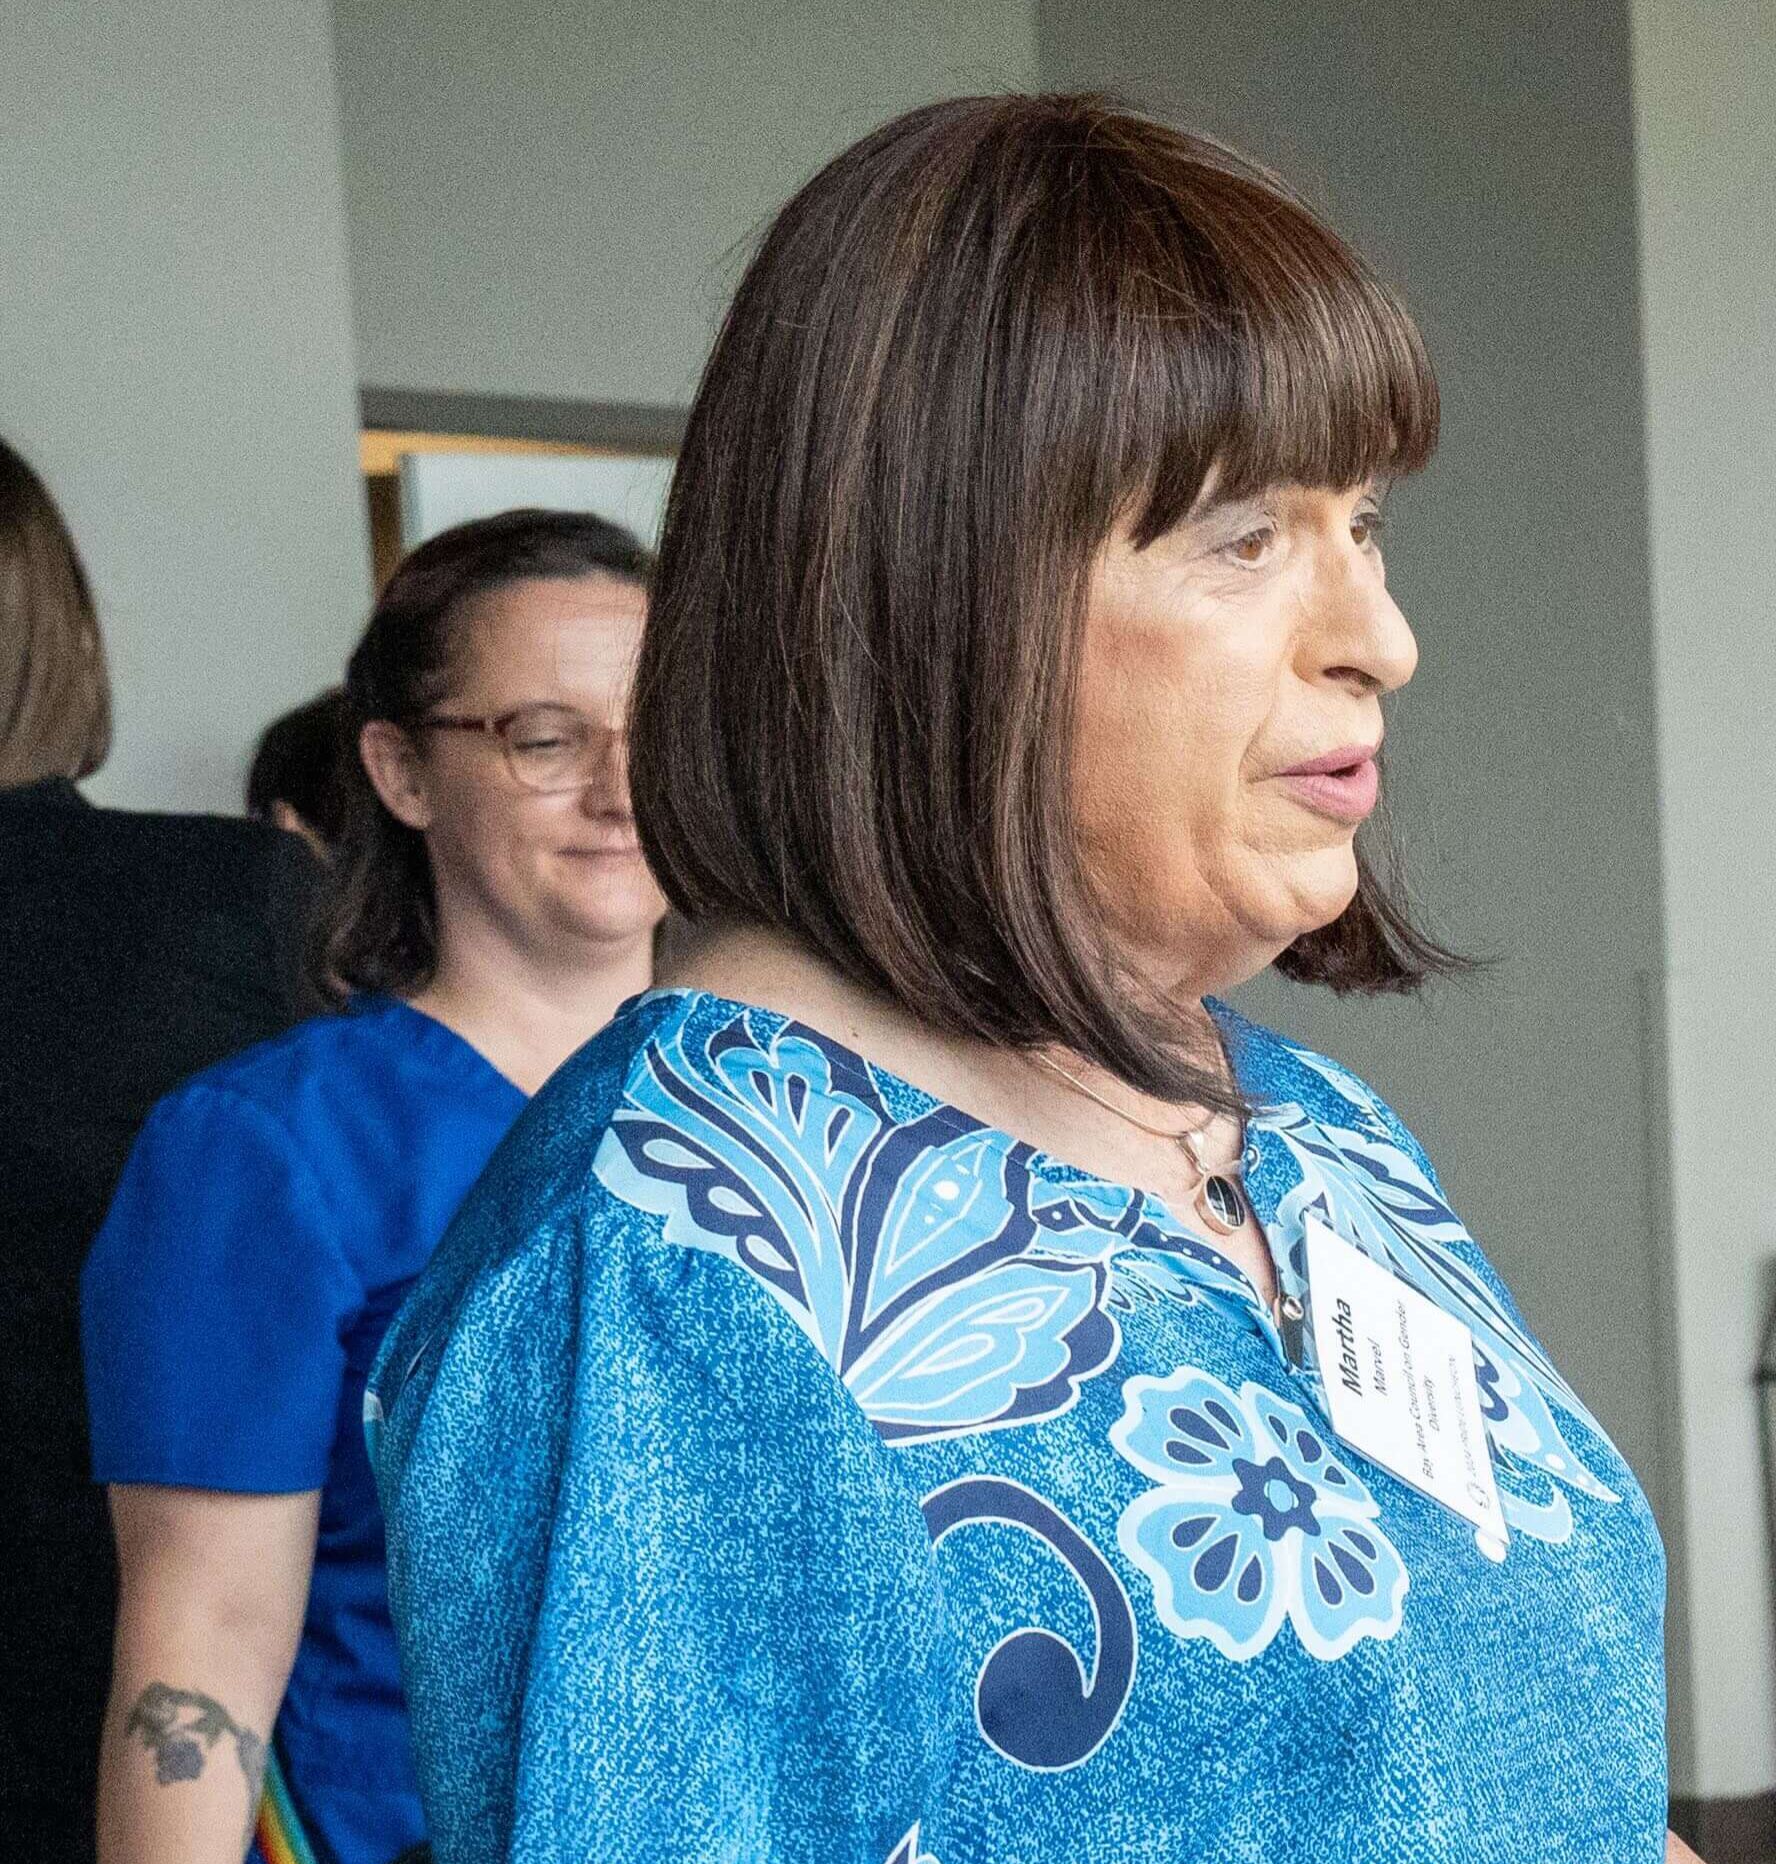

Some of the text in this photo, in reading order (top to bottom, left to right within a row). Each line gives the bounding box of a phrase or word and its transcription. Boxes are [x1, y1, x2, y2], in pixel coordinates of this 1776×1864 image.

[1331, 1298, 1363, 1397] Martha
[1366, 1336, 1388, 1396] Marvel
[1395, 1299, 1434, 1479] Bay Area Council on Gender
[1423, 1374, 1440, 1432] Diversity
